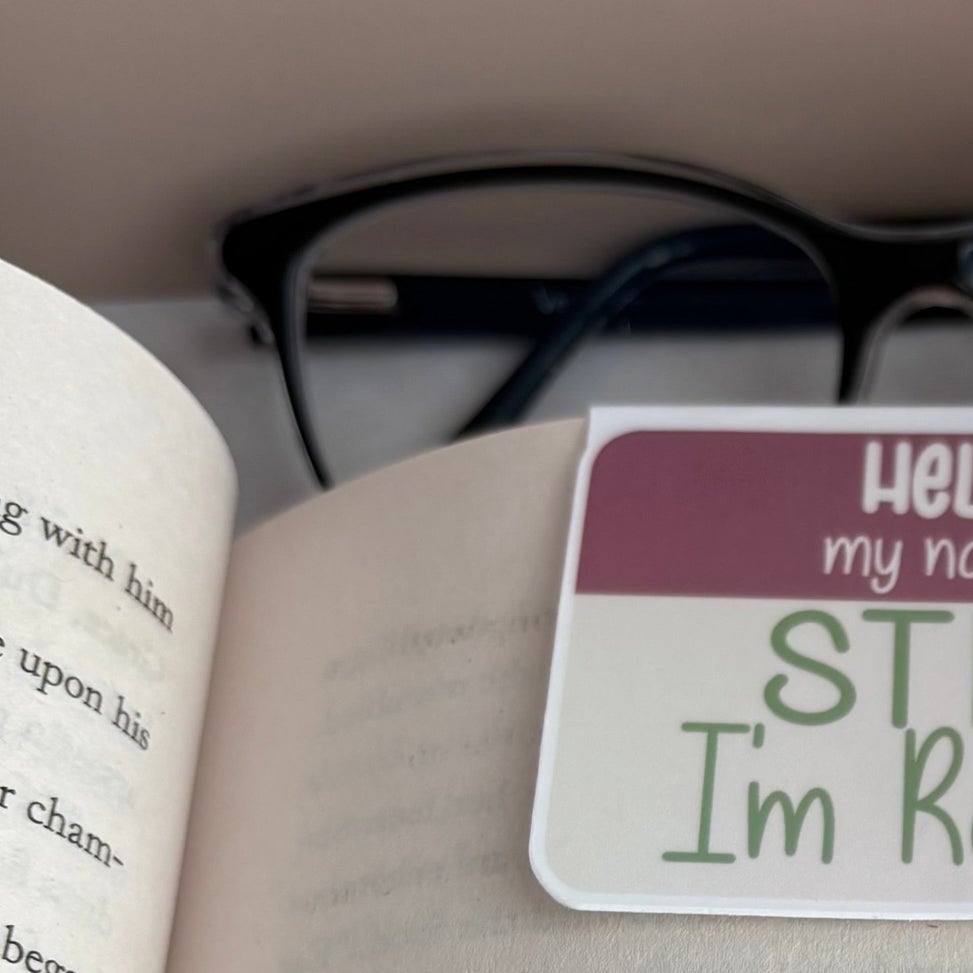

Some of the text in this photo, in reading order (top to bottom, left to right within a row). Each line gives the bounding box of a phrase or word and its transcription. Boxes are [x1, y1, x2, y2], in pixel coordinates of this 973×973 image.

[40, 517, 114, 581] with
[124, 563, 175, 632] him
[825, 536, 902, 593] my
[20, 648, 149, 750] upon his
[27, 797, 123, 867] cham-
[661, 721, 836, 864] I'm
